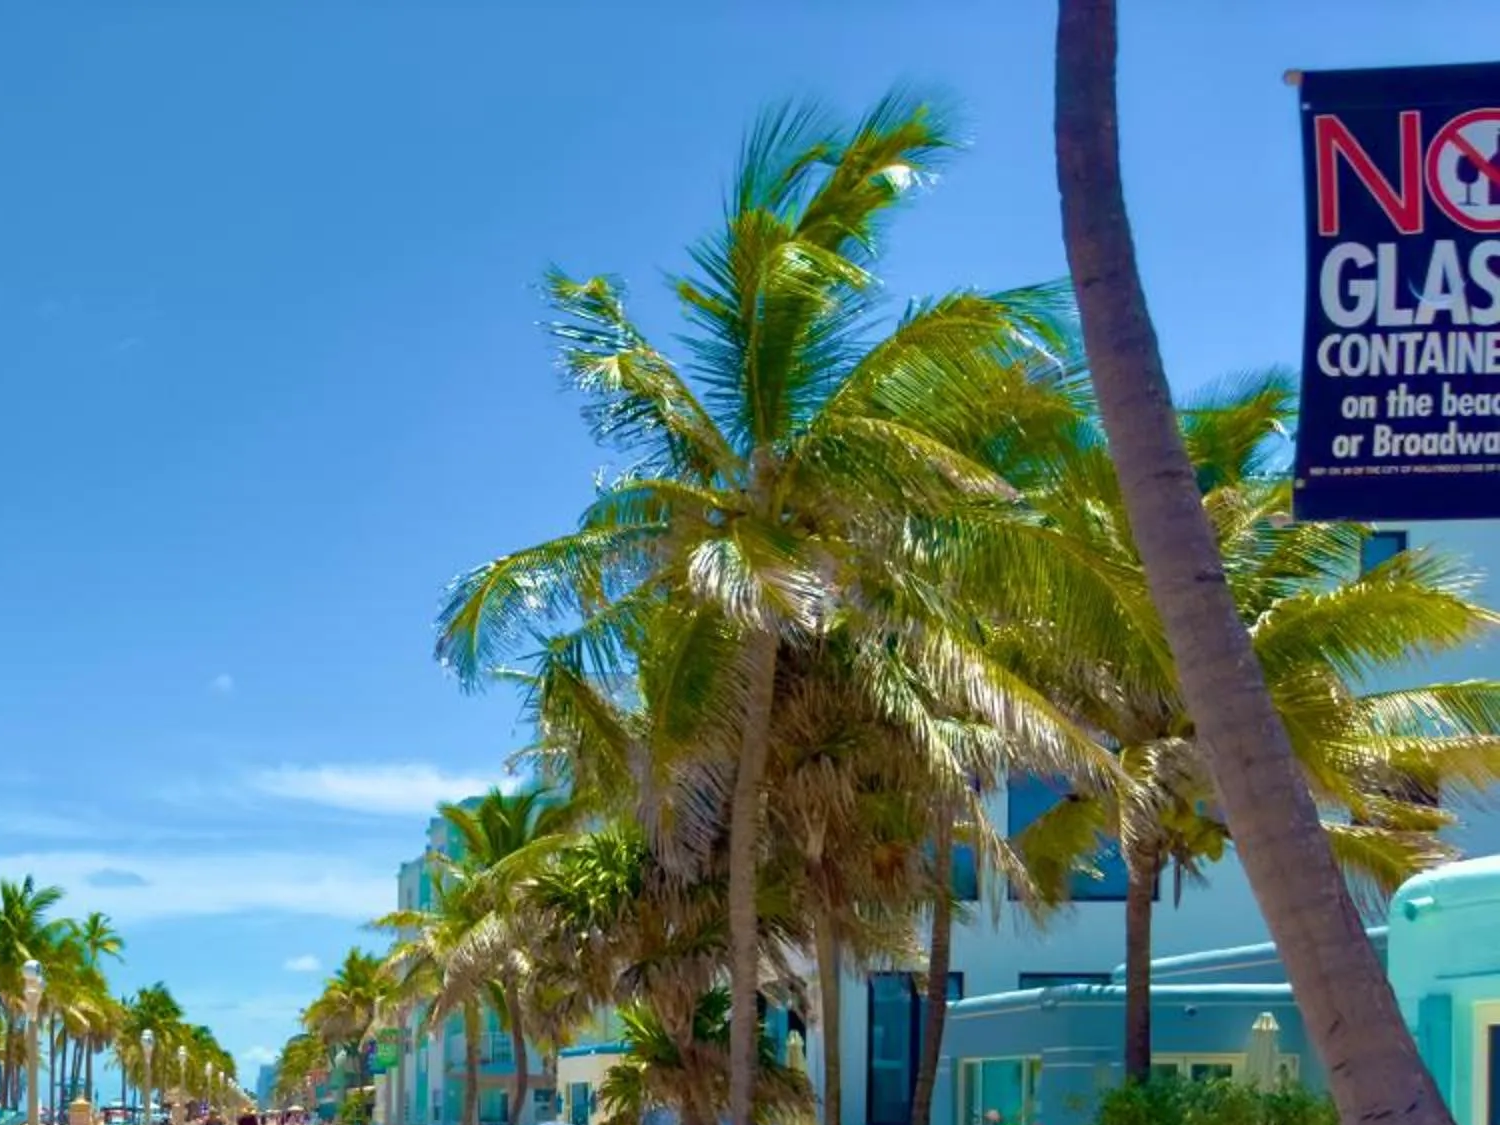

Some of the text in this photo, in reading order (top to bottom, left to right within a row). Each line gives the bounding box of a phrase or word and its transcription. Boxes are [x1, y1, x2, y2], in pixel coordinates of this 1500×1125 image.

[1319, 240, 1500, 328] GLAS
[1317, 331, 1500, 377] CONTAINE
[1341, 395, 1377, 419] on
[1386, 382, 1433, 418] the
[1332, 420, 1500, 458] or Broadwa
